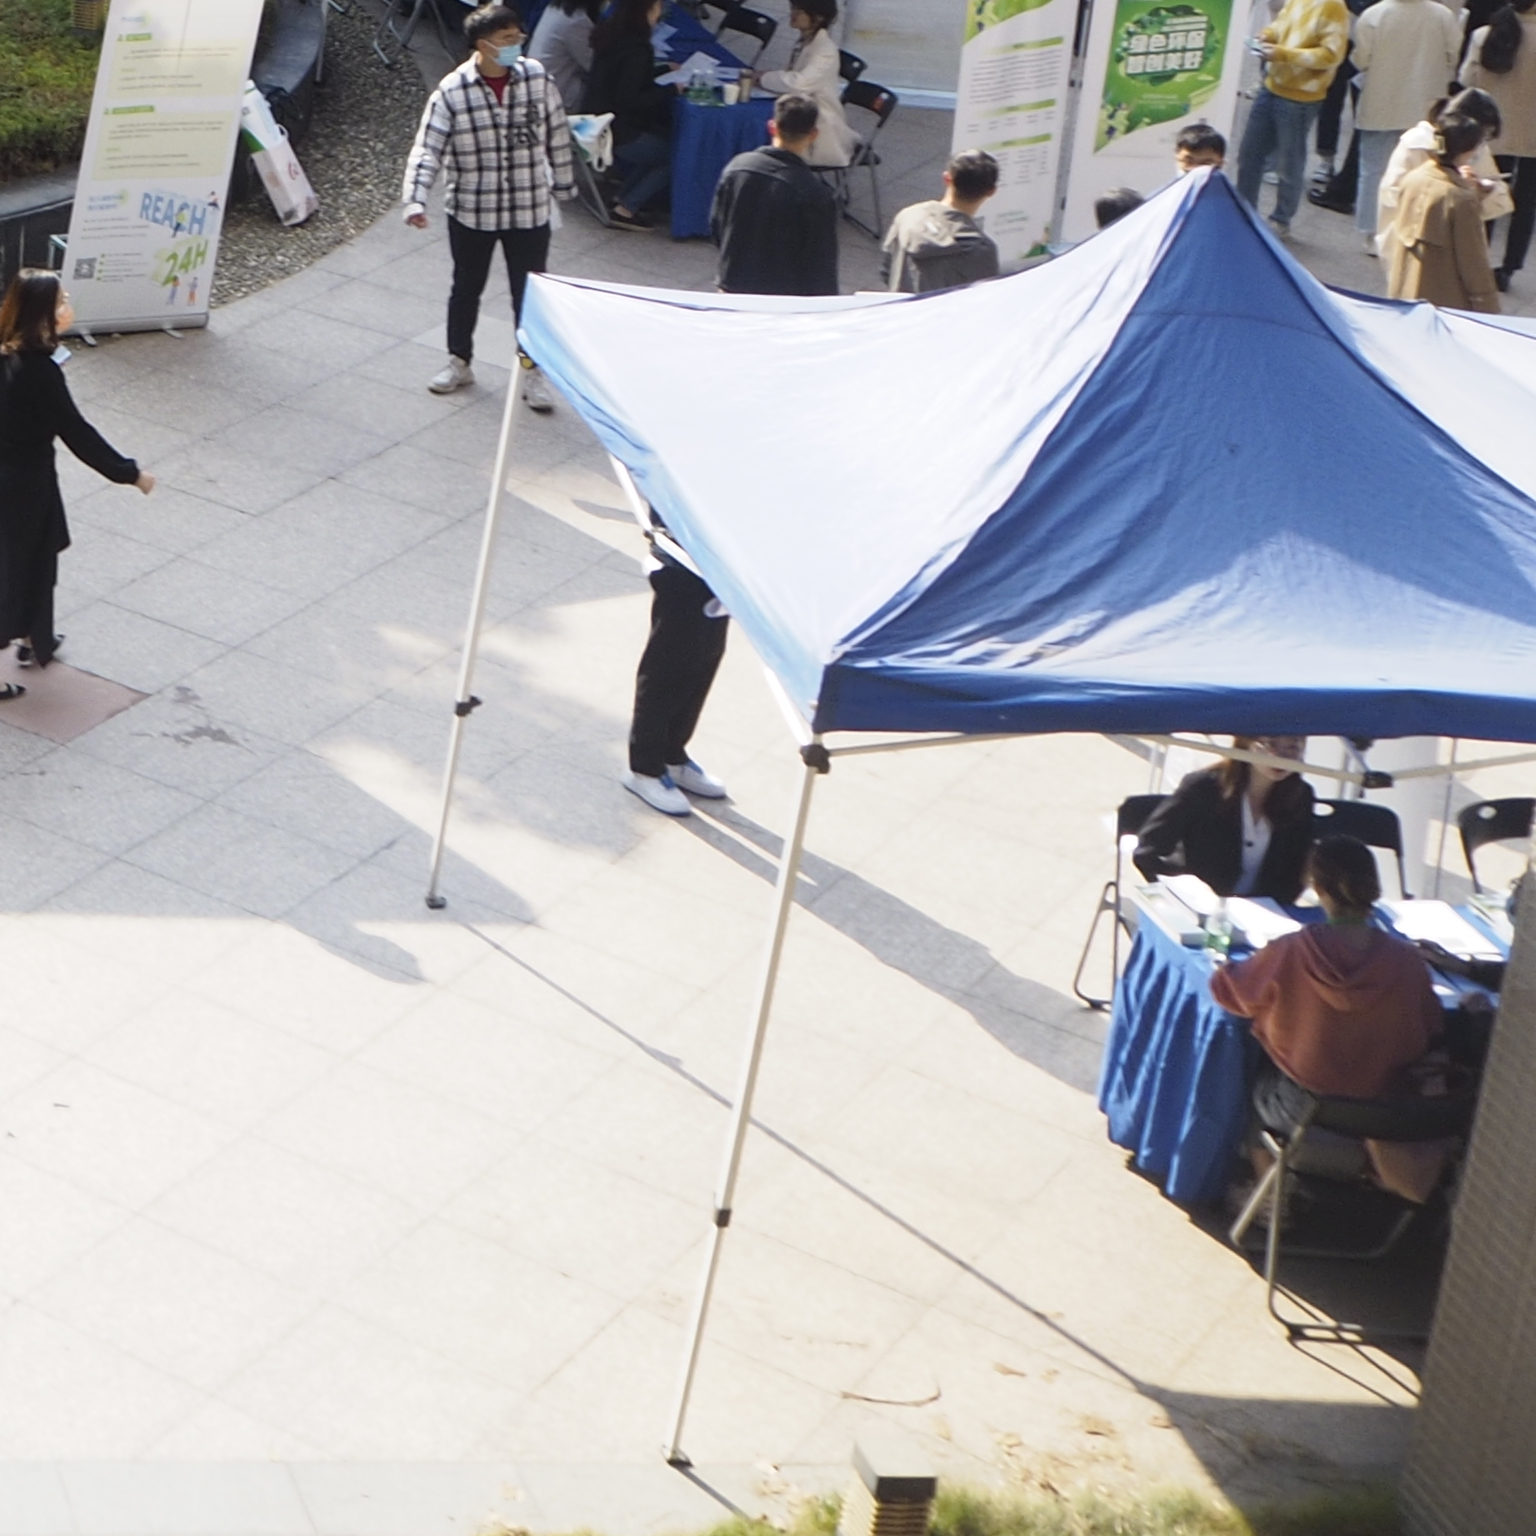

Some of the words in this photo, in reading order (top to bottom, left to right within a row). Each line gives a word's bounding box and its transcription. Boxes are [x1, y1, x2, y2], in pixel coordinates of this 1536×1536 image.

[1129, 30, 1207, 53] 绿色环保
[140, 192, 207, 236] REACH
[161, 239, 209, 287] 24H
